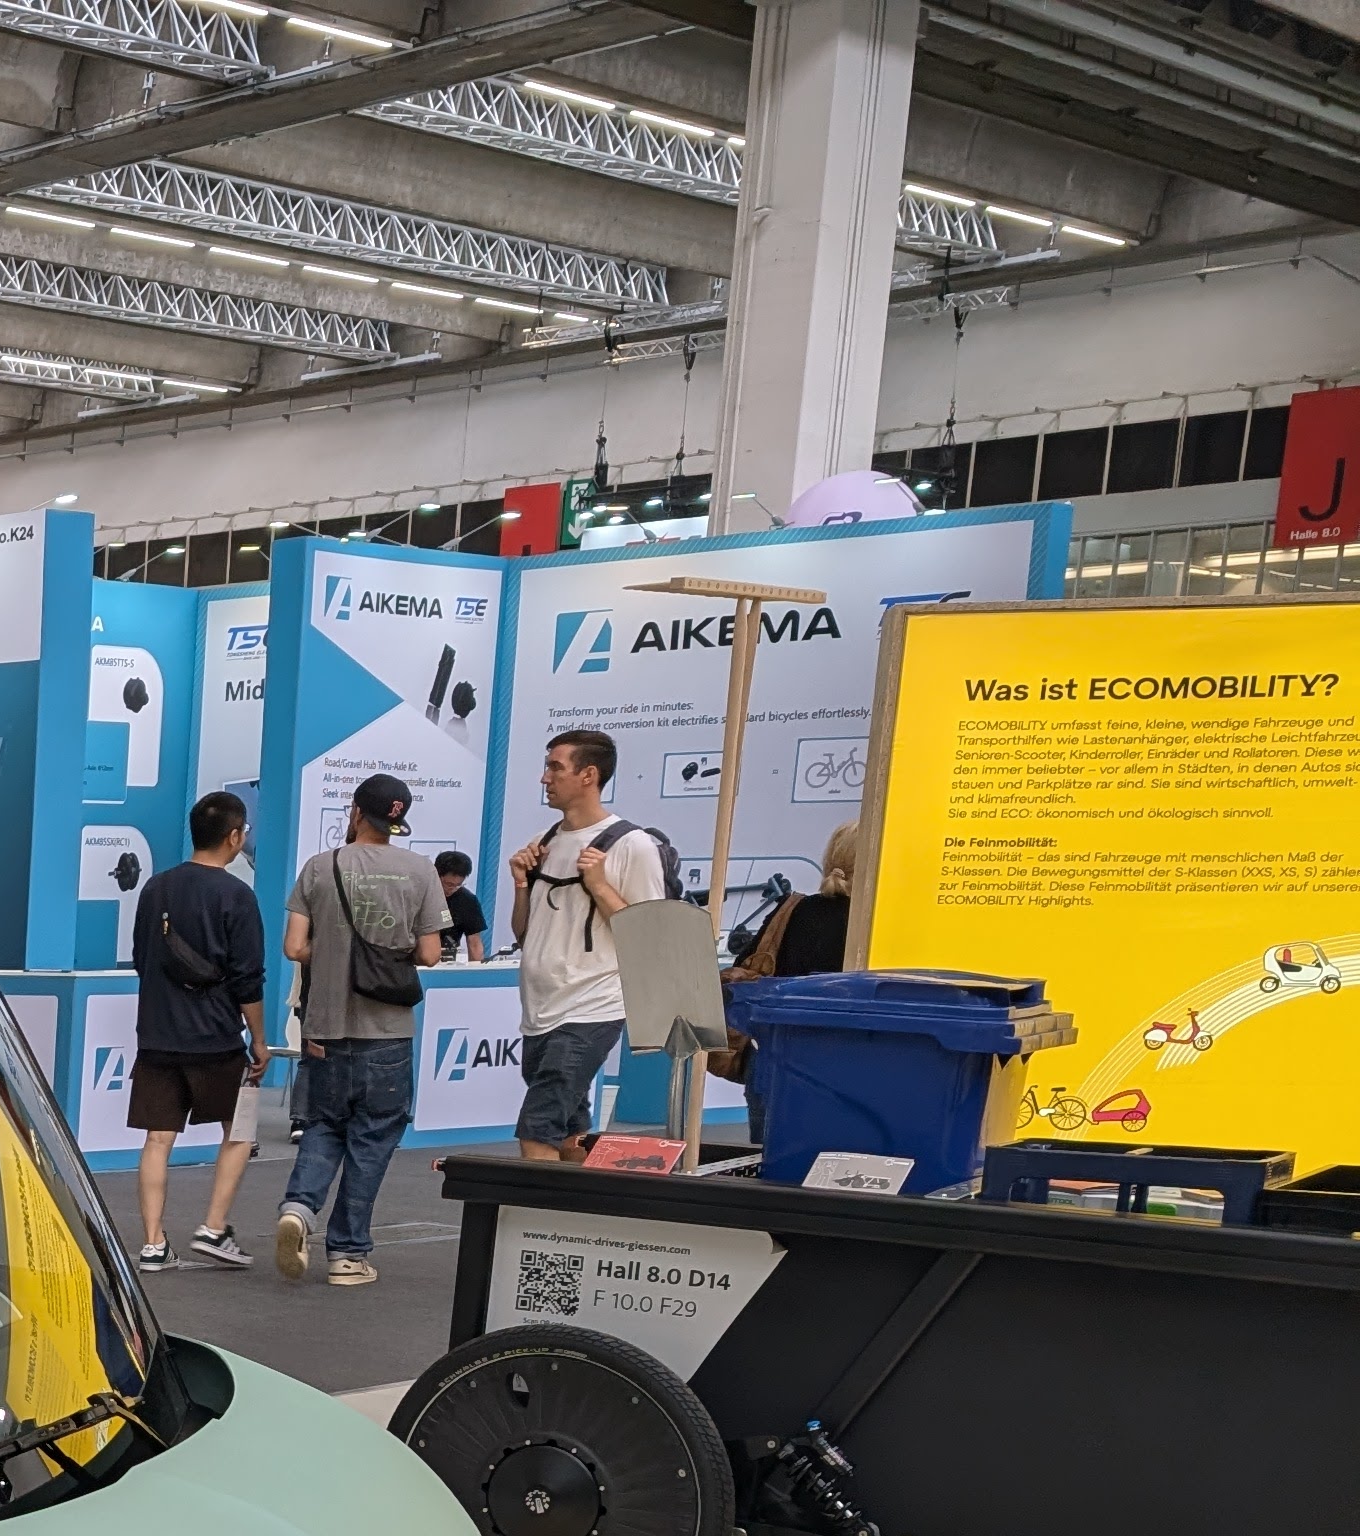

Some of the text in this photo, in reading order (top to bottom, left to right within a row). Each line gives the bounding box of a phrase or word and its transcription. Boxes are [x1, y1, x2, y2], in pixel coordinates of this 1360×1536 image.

[1299, 457, 1345, 521] J
[1290, 527, 1341, 540] Halle 8.0
[359, 590, 443, 619] AIKEMA
[630, 607, 842, 654] AIKEMA
[964, 673, 1339, 701] Was ist ECOMOBILITY?
[549, 707, 593, 718] Transform
[596, 707, 618, 718] your
[620, 703, 638, 714] ride
[641, 703, 651, 713] in
[546, 706, 872, 733] A mid-drive conversion kit electrifies bicycles effortlessly.
[958, 716, 1355, 731] ECOMOBILITY umfasst feine, kleine, wendige Fahrzeuge und
[957, 735, 1052, 747] Transporthilfen
[1057, 735, 1079, 745] wie
[1083, 733, 1190, 747] Lastenanhänger,
[1194, 733, 1267, 744] elektrische
[955, 747, 1342, 761] Senioren-Scooter, Kinderroller, Einräder und Rollatoren. Diese
[324, 757, 362, 769] Road/Gravel
[363, 760, 376, 769] Hub
[378, 760, 407, 771] Thru-Axle
[953, 762, 1341, 775] den immer beliebter vor allem in Städten, in denen Autos
[323, 773, 462, 788] All-in-one & interface.
[951, 776, 1358, 791] stauen und Parkplätze rar sind. Sie sind wirtschaftlich, umwelt-
[322, 788, 339, 798] Sleek
[950, 793, 1076, 804] und klimafreundlich.
[948, 807, 1274, 820] Sie sind ECO: ökonomisch und ökologisch sinnvoll.
[944, 837, 1057, 847] Die Feinmobilität:
[943, 851, 1344, 864] Feinmobilität das sind Fahrzeuge mit menschlichen Maß der
[941, 866, 1317, 879] S-Klassen. Die Bewegungsmittel der S-Klassen (XXS, XS, S)
[939, 880, 1308, 894] zur Feinmobilität. Diese Feinmobilität präsentieren wir auf
[937, 895, 1094, 908] ECOMOBILITY Highlights.
[471, 1038, 522, 1068] AIK
[523, 1230, 691, 1255] www.dynamic-drives-giessen.com
[596, 1259, 731, 1291] Hall 8.0 D14
[593, 1289, 697, 1318] F 10.0 F29
